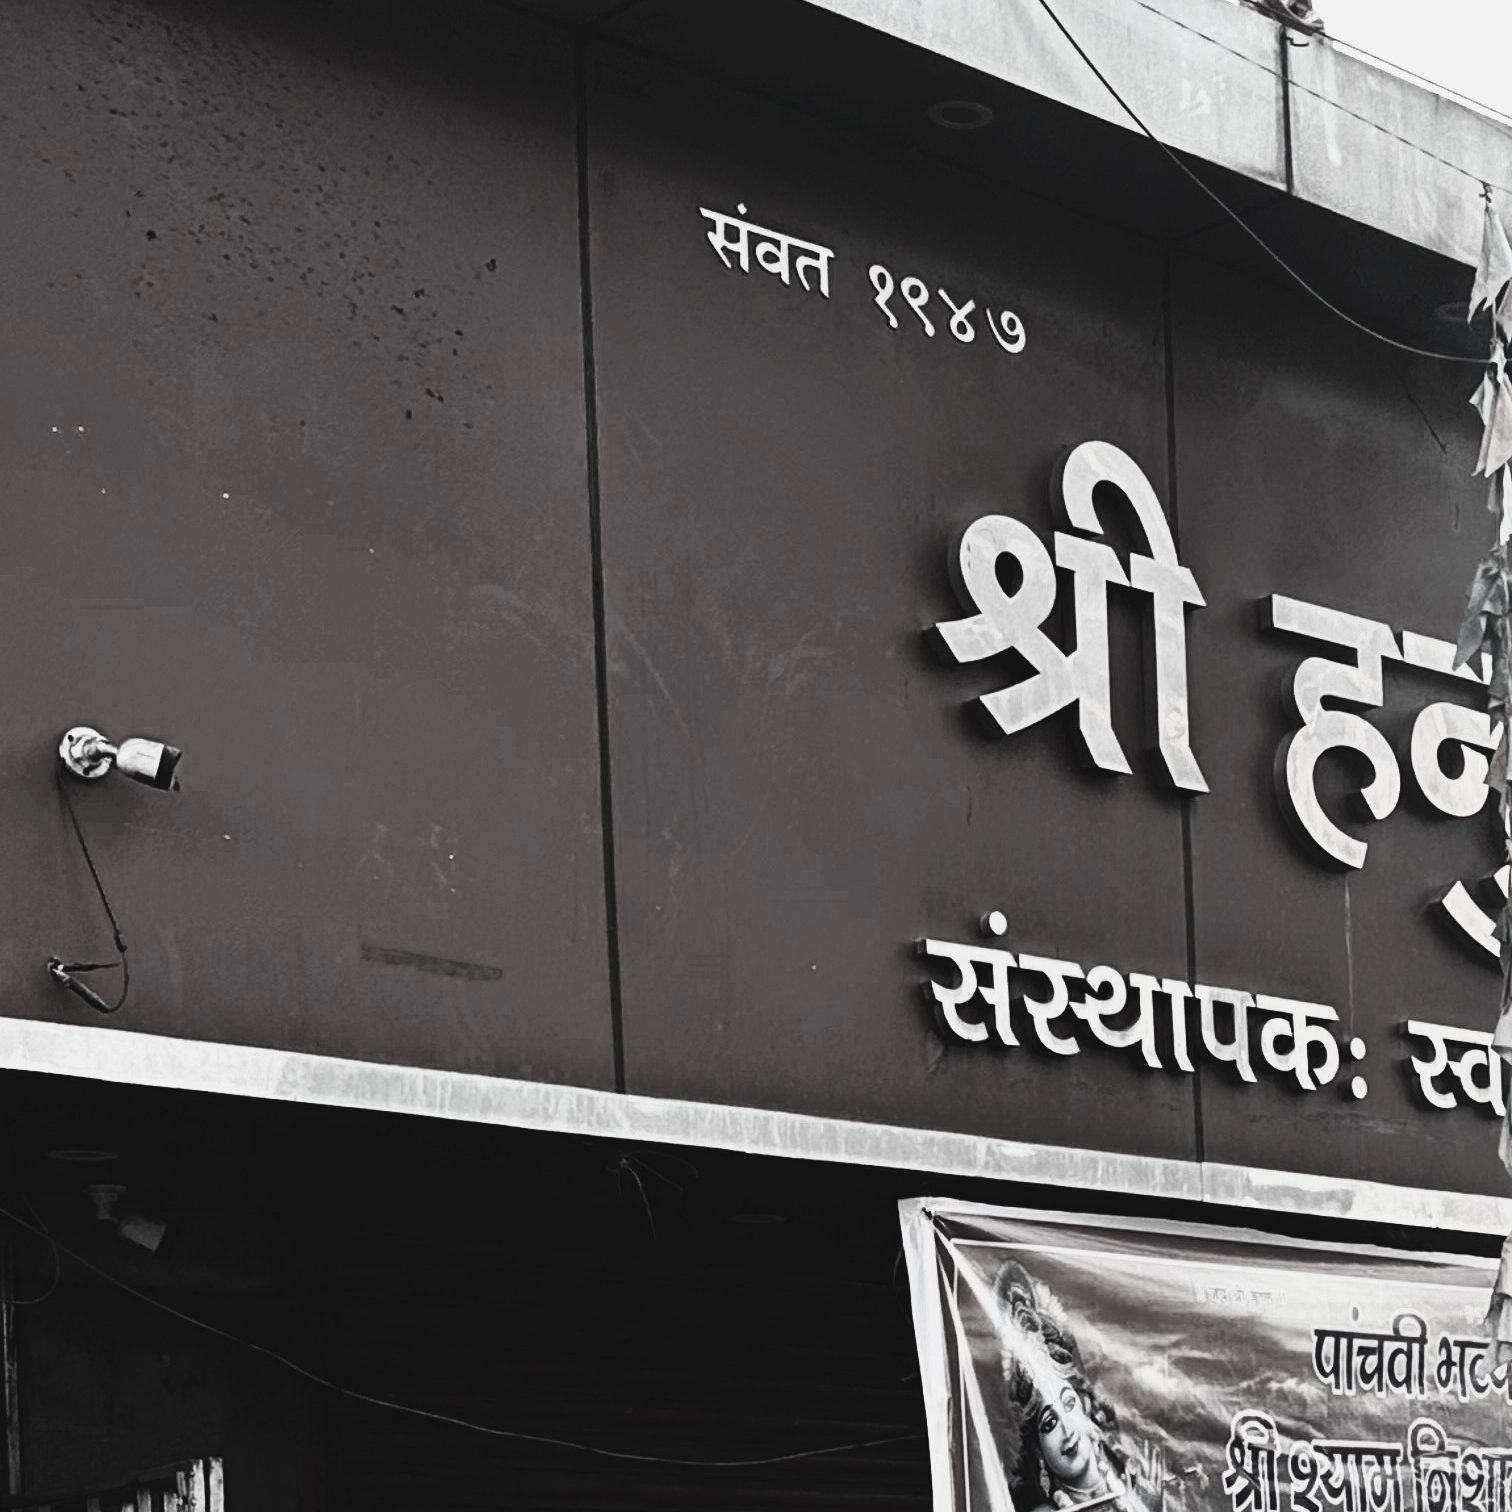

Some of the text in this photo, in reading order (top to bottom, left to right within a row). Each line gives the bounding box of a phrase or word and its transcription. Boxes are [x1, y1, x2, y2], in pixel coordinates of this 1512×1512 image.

[700, 203, 1026, 353] संवत १९४७
[936, 440, 1209, 793] श्री
[1312, 1306, 1430, 1398] पांचवी
